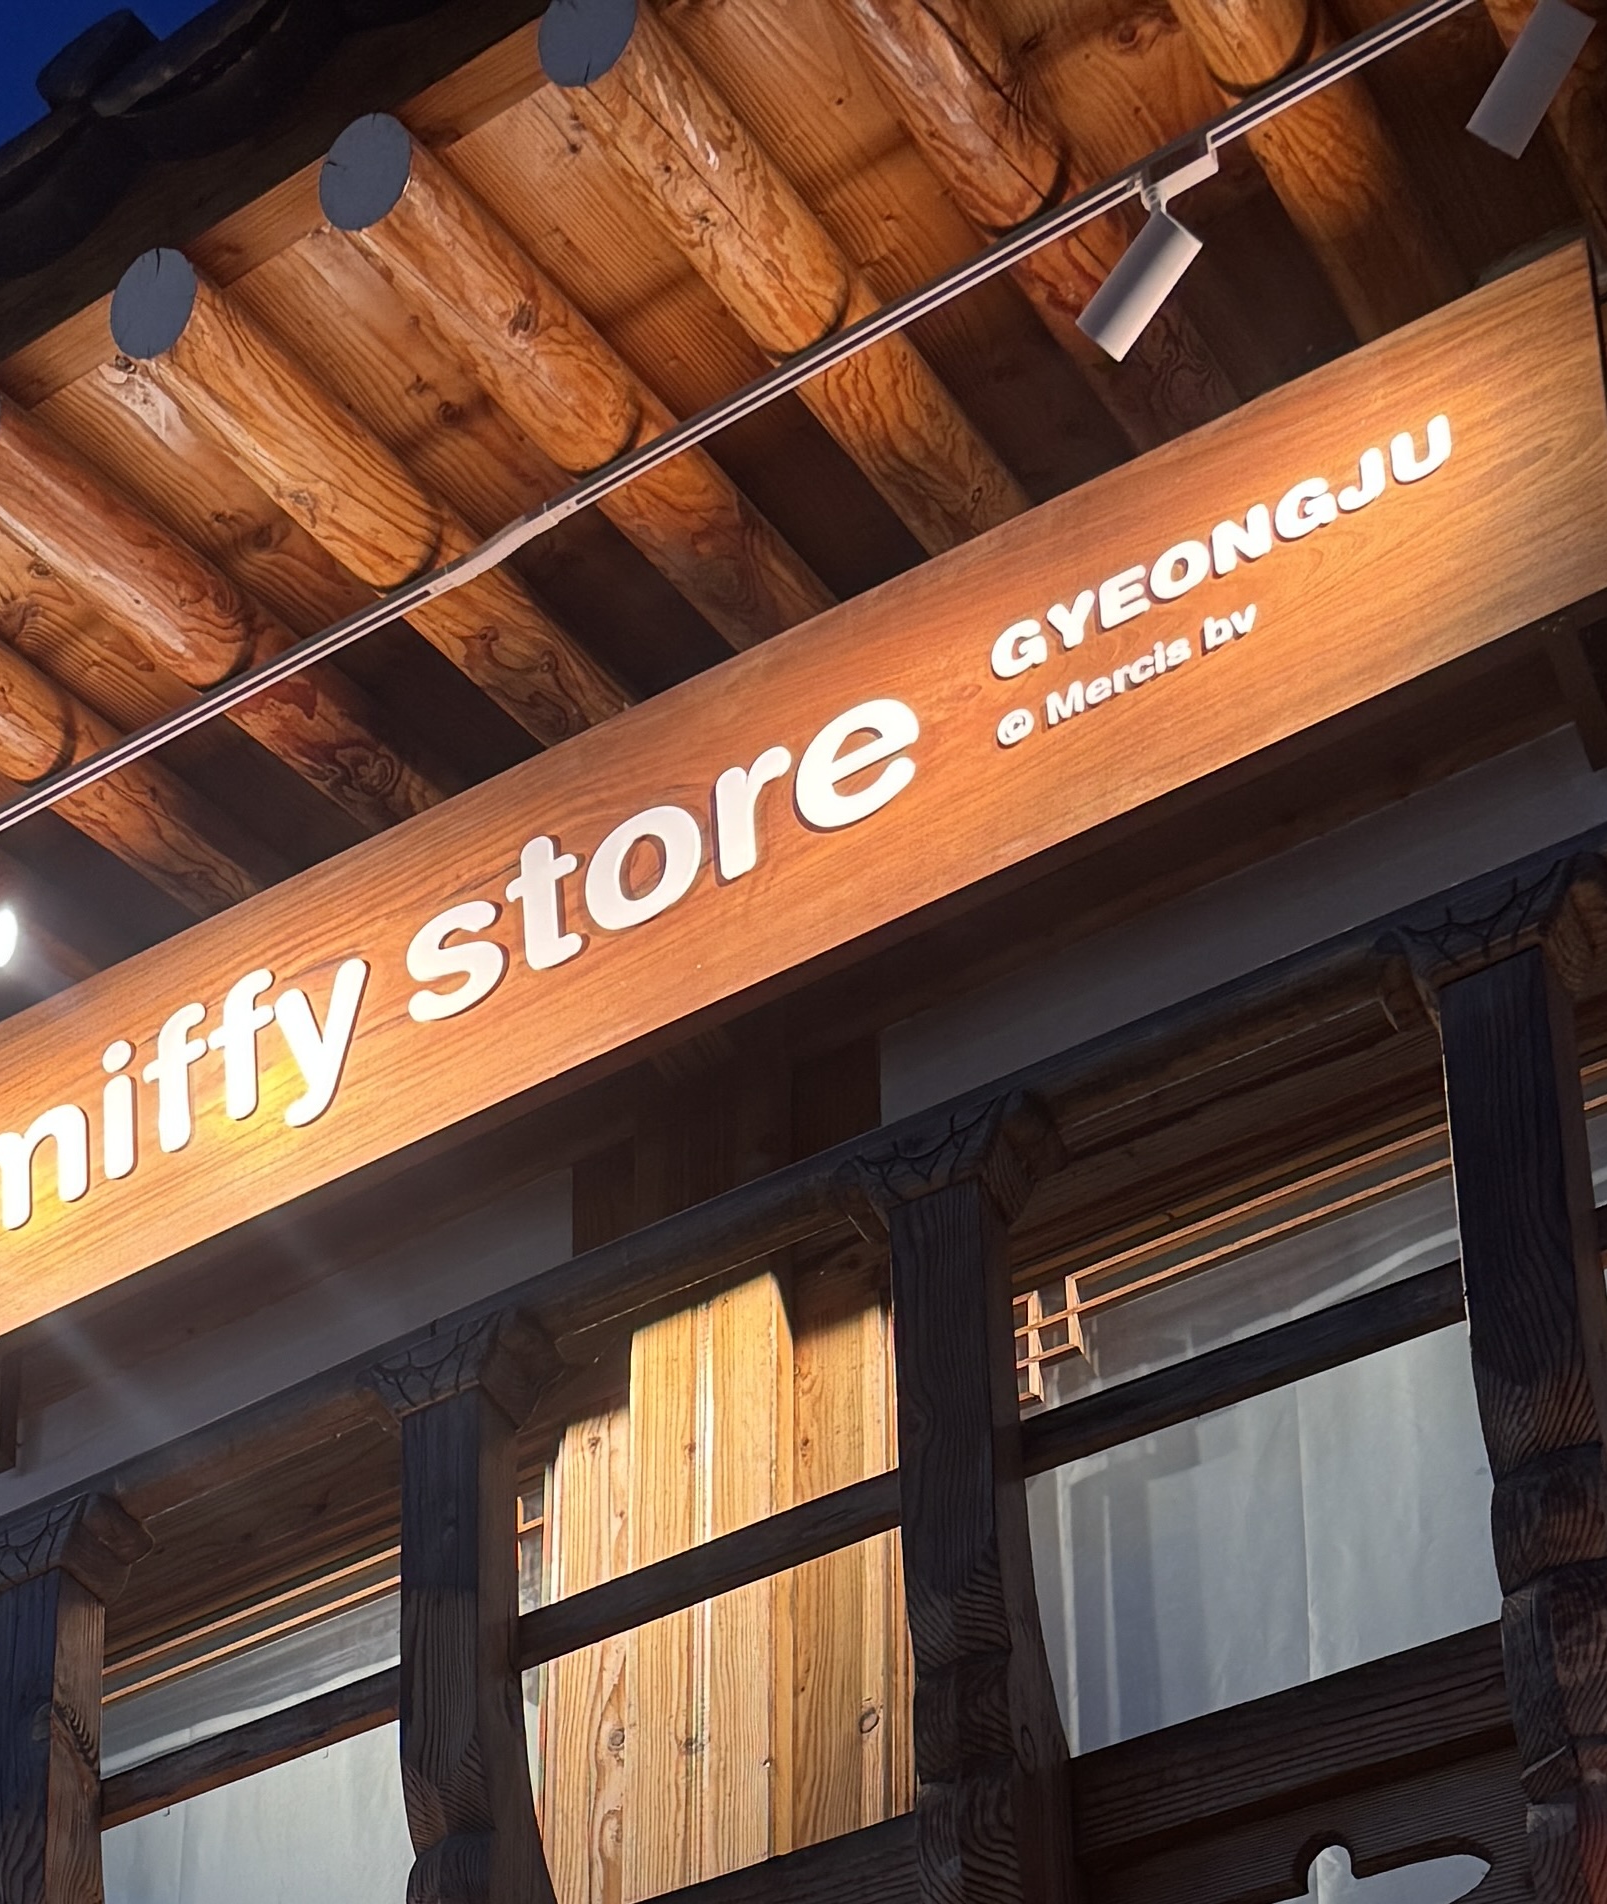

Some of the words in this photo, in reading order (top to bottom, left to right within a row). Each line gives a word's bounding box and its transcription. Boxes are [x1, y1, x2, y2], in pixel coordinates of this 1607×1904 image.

[991, 414, 1454, 678] GYEONGJU
[1044, 636, 1192, 728] Mercis
[1201, 604, 1258, 654] bv
[407, 697, 922, 1024] store
